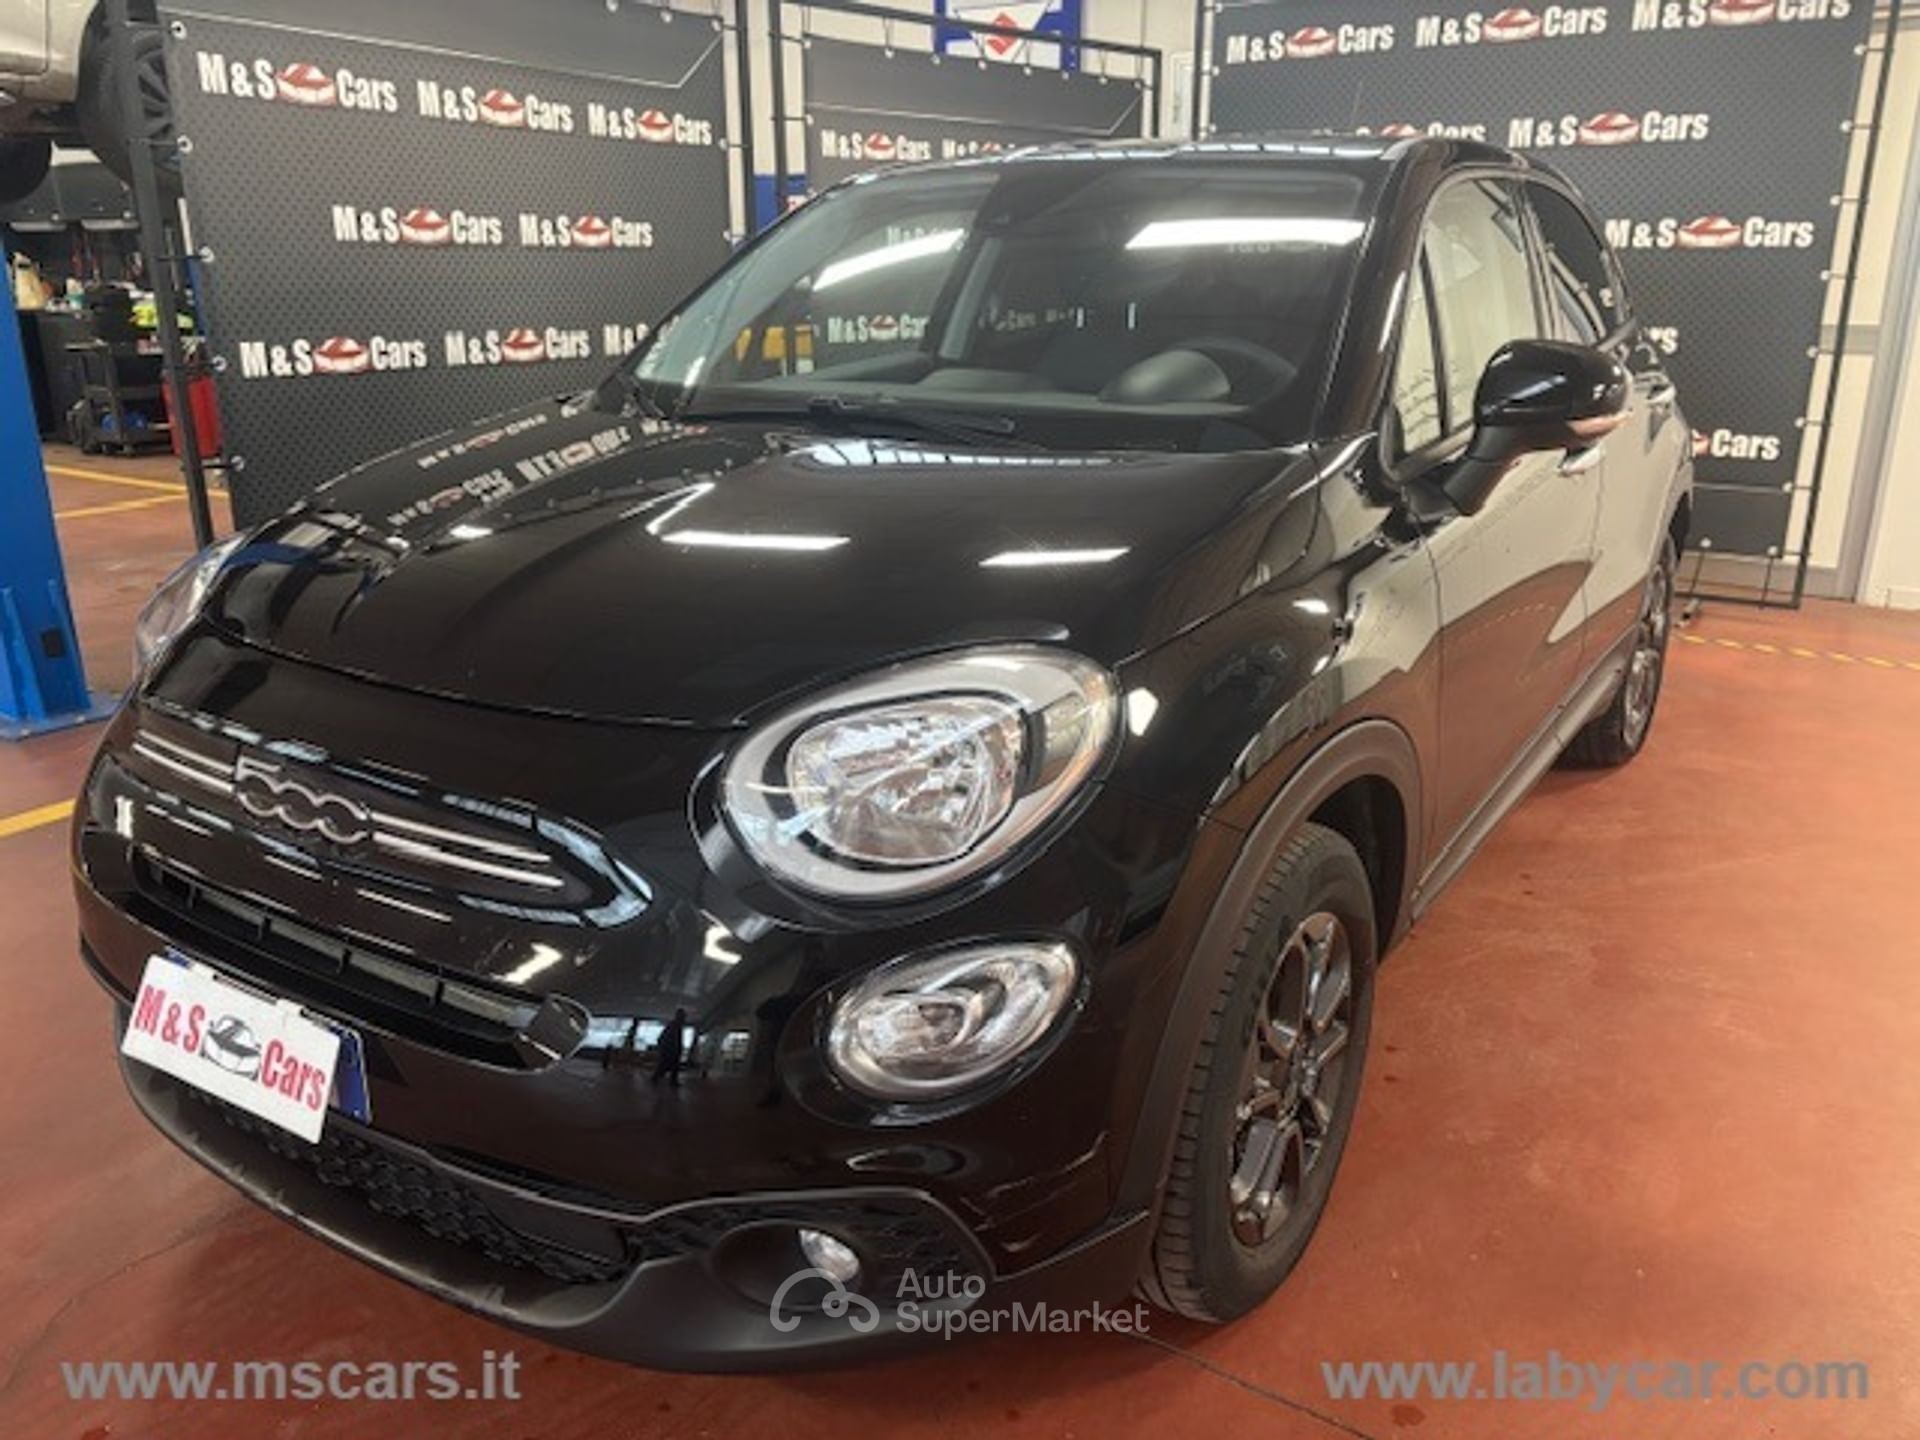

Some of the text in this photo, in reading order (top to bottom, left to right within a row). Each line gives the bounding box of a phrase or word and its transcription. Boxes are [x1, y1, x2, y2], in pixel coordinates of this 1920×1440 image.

[1542, 5, 1607, 37] Cars
[1337, 23, 1394, 54] Cars
[336, 68, 398, 112] Cars
[524, 94, 573, 133] Cars
[674, 113, 712, 145] Cars
[1640, 111, 1709, 142] Cars
[896, 135, 932, 161] Cars
[450, 209, 502, 246] Cars
[611, 217, 653, 248] Cars
[1743, 216, 1814, 248] Cars
[545, 326, 590, 358] Cars
[899, 313, 929, 339] Car
[368, 335, 427, 369] Cars
[1710, 428, 1780, 461] Cars
[258, 1039, 327, 1112] Cars
